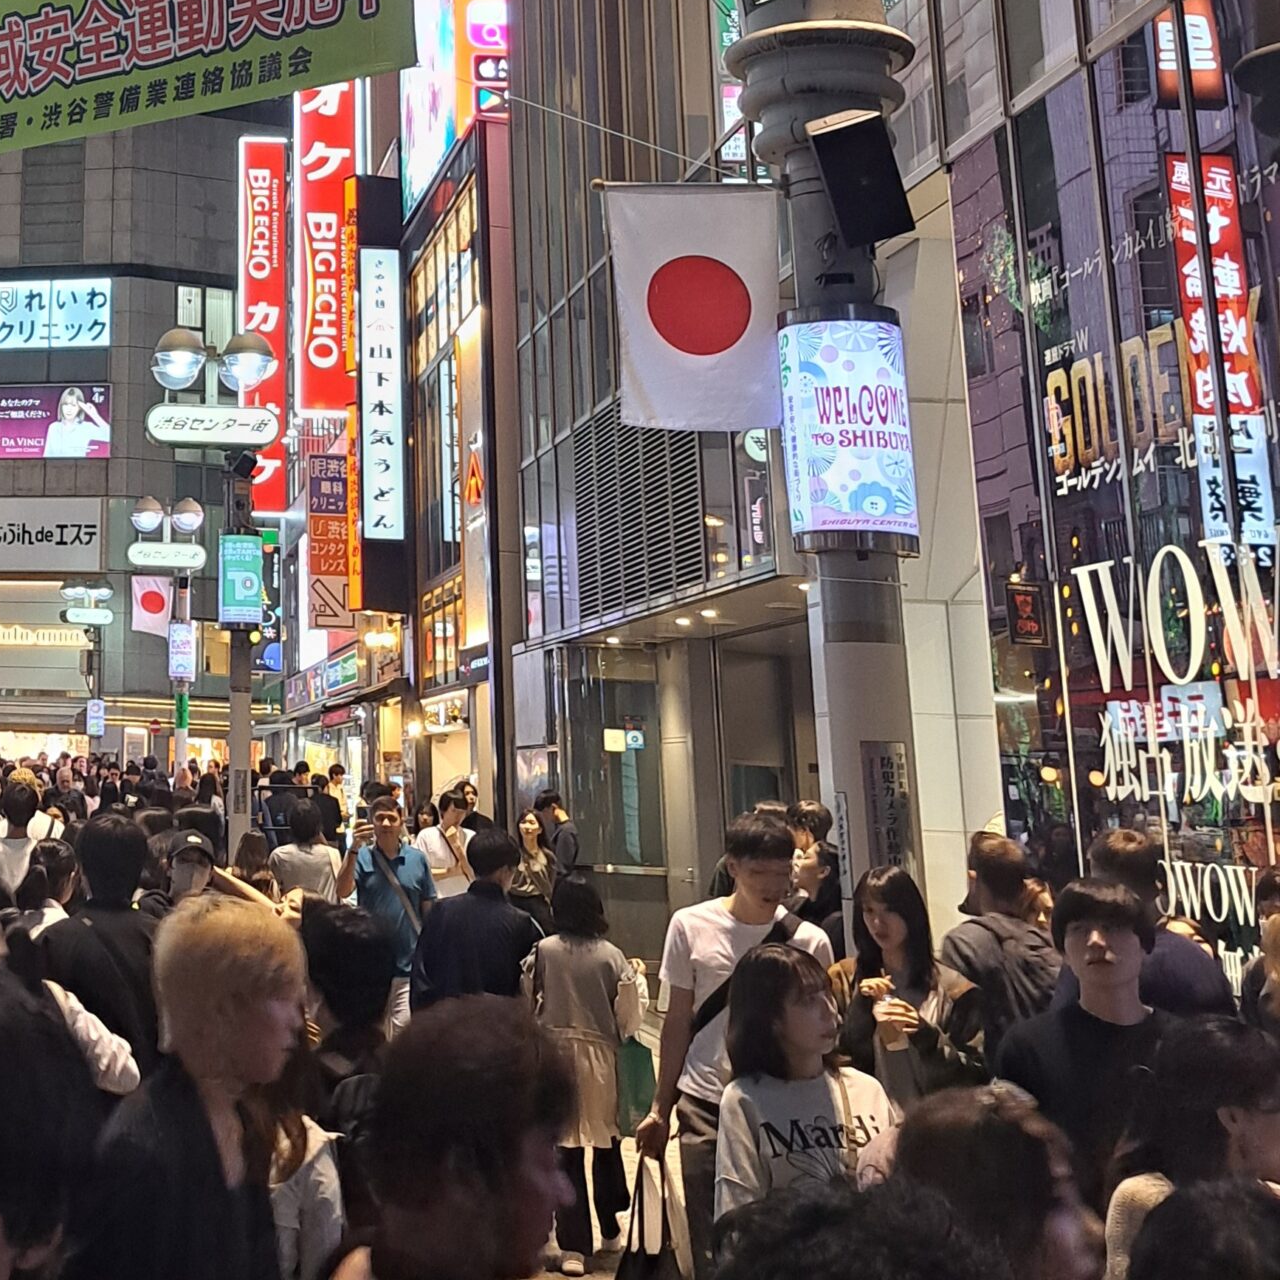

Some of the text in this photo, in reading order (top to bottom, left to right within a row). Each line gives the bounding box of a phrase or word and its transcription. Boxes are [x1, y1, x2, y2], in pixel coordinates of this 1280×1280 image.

[248, 167, 272, 280] BIG ECHO
[24, 287, 108, 313] れいわ
[305, 211, 339, 369] BIG ECHO
[814, 384, 908, 427] WELCOME
[154, 416, 272, 433] 渋谷センター街
[369, 344, 396, 530] 山下本気うどん
[2, 438, 45, 446] DA VINCI
[811, 429, 912, 454] TO SHIBUYA
[311, 496, 348, 511] クリニッ
[821, 517, 871, 527] SHIBUYA
[872, 518, 907, 528] CENTER
[321, 558, 346, 572] レンズ
